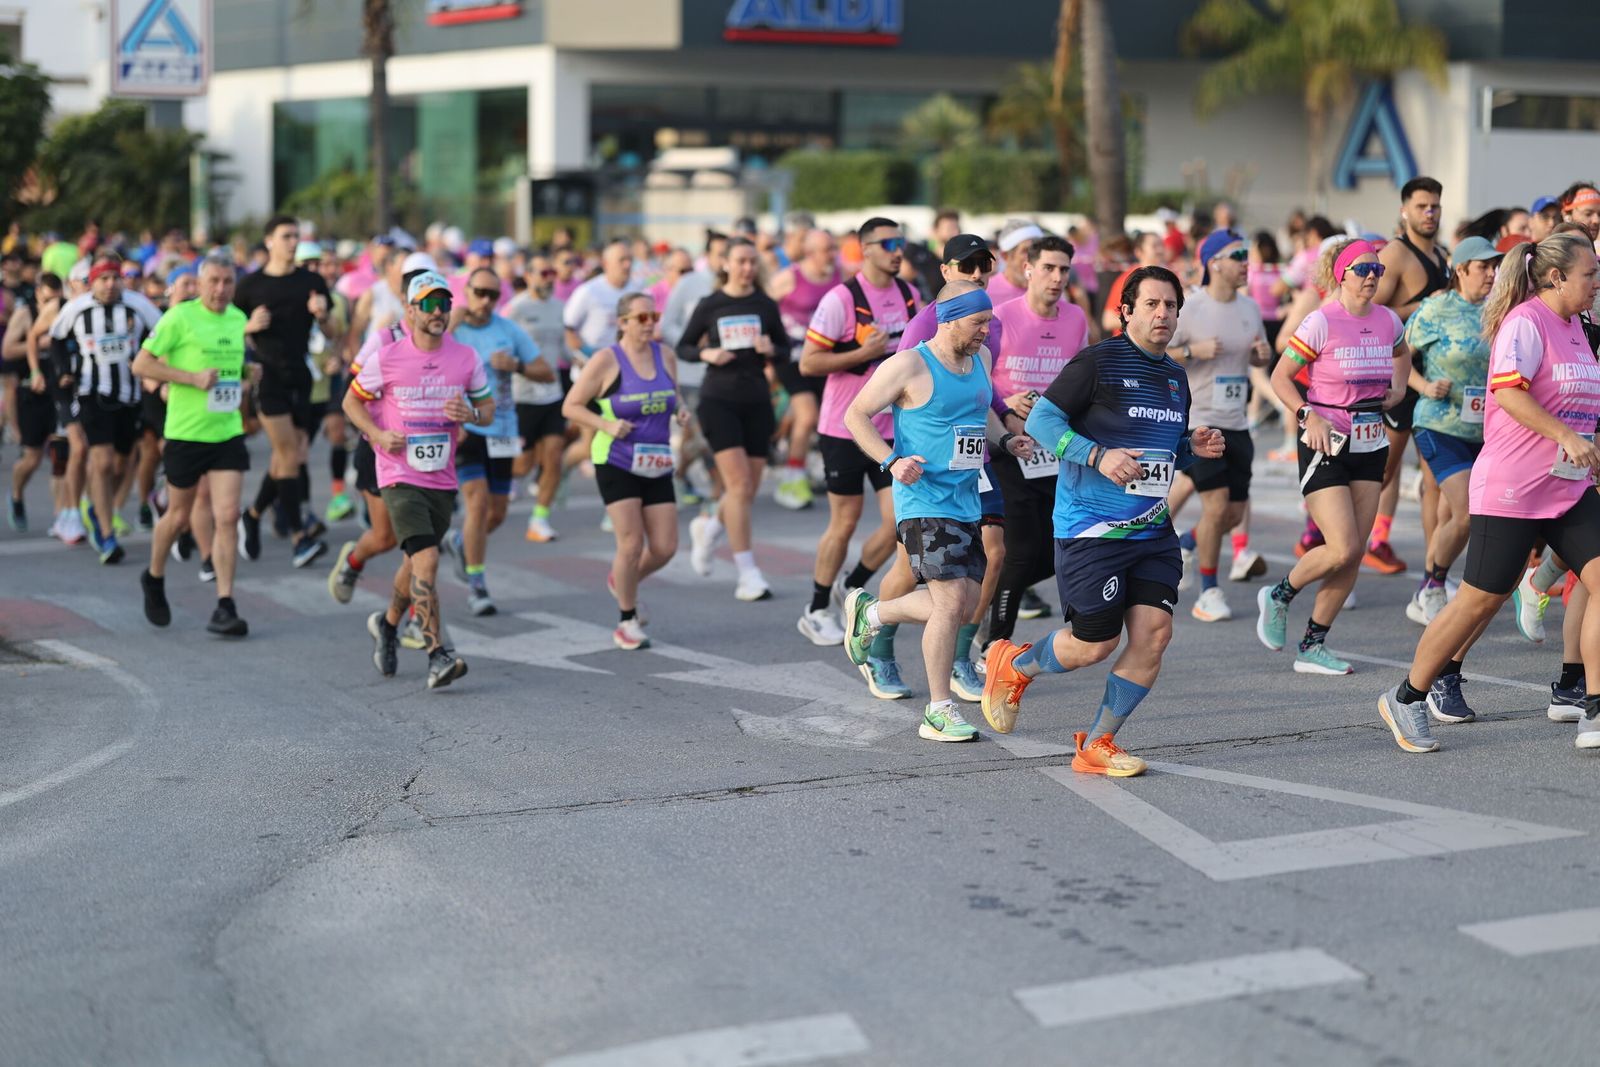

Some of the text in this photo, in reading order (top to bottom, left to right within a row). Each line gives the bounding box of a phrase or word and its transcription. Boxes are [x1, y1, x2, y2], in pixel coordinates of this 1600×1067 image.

[1334, 346, 1365, 360] MEDIA
[1005, 355, 1040, 371] MEDIA
[215, 388, 237, 402] 551
[1225, 384, 1242, 399] 52
[1128, 406, 1183, 423] enerplus
[415, 444, 444, 459] 637
[1130, 501, 1164, 526] Maratón
